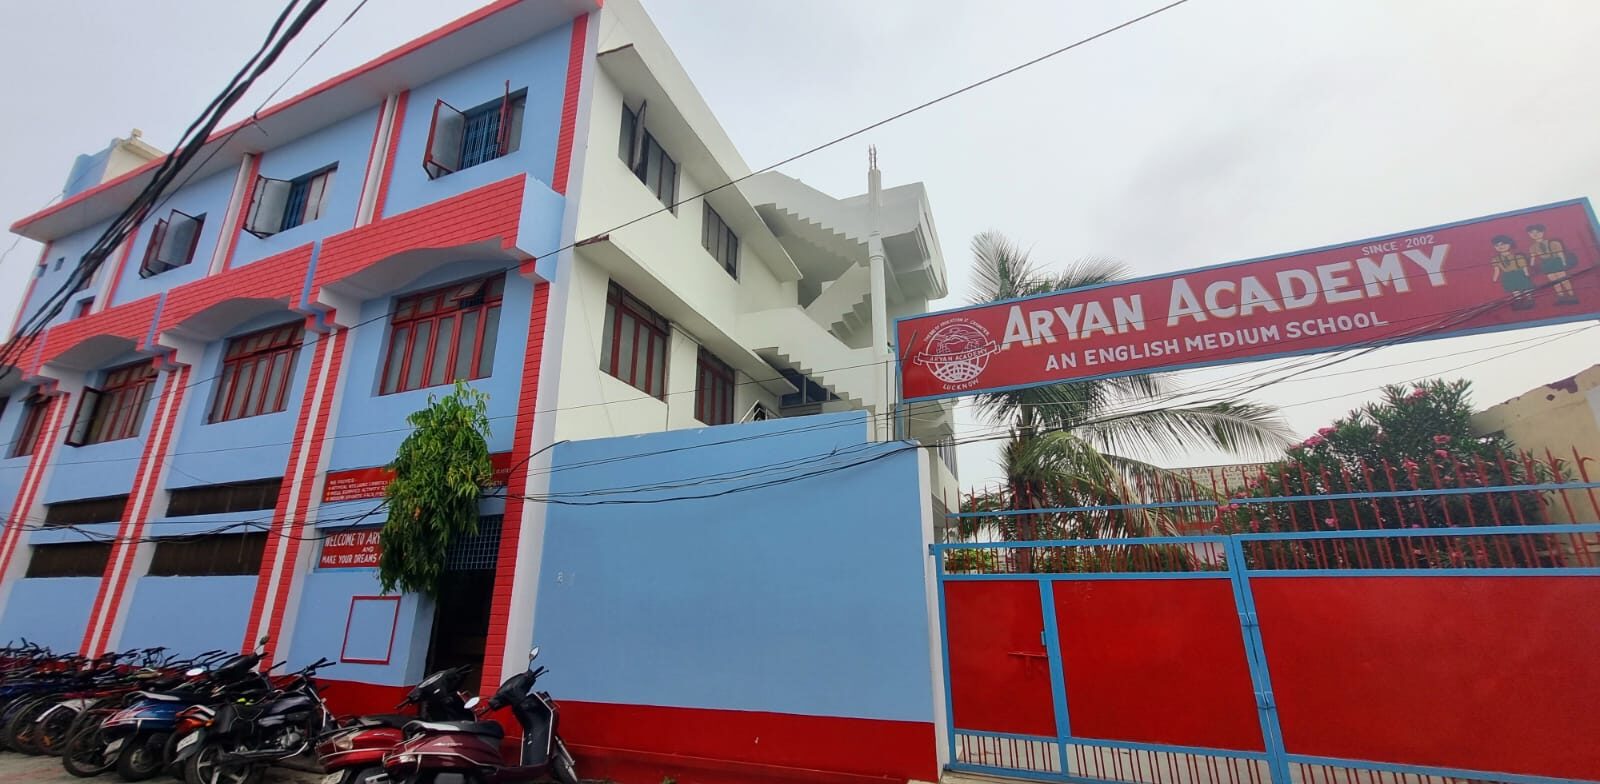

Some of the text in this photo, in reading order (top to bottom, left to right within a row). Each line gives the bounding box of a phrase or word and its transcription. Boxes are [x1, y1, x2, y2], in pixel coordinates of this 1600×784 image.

[1362, 234, 1435, 257] SINCE 2002
[1000, 243, 1451, 351] ARYAN ACADEMY
[1045, 311, 1390, 372] AN ENGLISH MEDIUM SCHOOL
[930, 348, 988, 363] ARYAN ACADEMY
[943, 378, 979, 391] LUCKNOW
[325, 531, 381, 547] WELCOME TO ARY
[361, 545, 375, 553] AND
[321, 554, 337, 565] MAKE
[338, 554, 353, 564] YOUR
[353, 553, 378, 564] DREAMS
